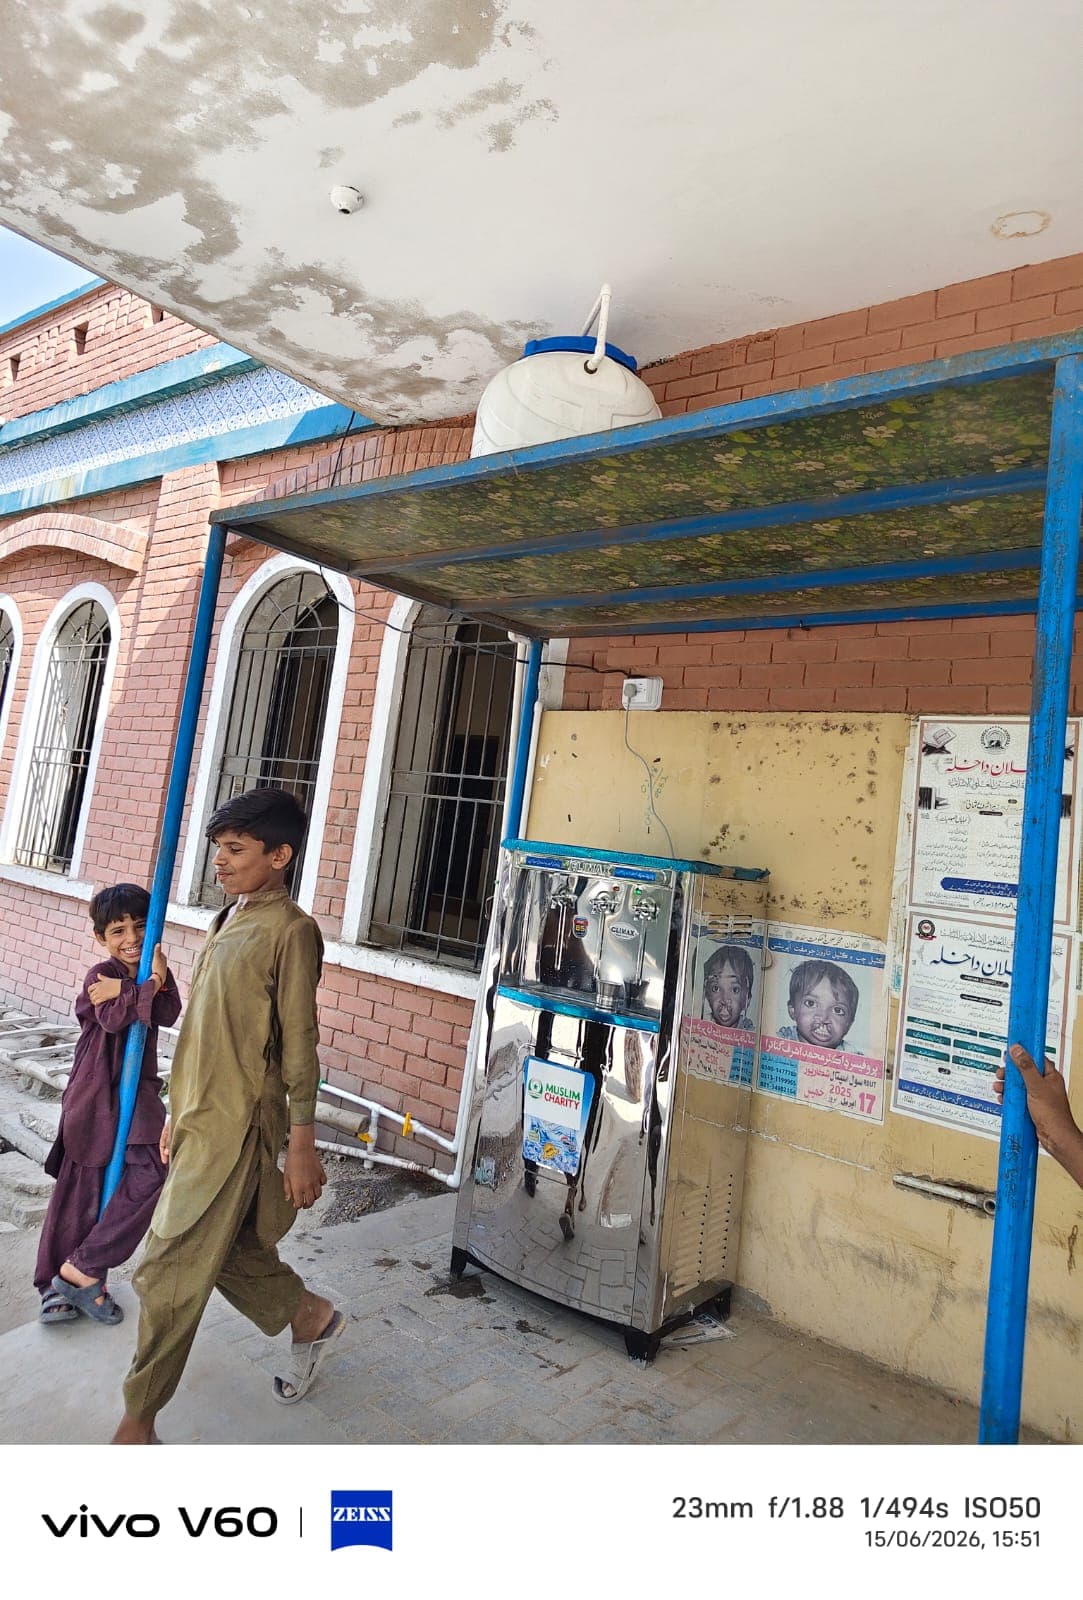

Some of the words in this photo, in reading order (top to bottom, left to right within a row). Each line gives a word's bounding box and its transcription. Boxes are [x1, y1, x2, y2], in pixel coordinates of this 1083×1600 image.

[610, 926, 636, 937] CLIMAX
[545, 1082, 580, 1101] MUSLIM
[829, 1084, 852, 1098] 2025
[544, 1092, 580, 1111] CHARITY
[858, 1091, 877, 1115] 17
